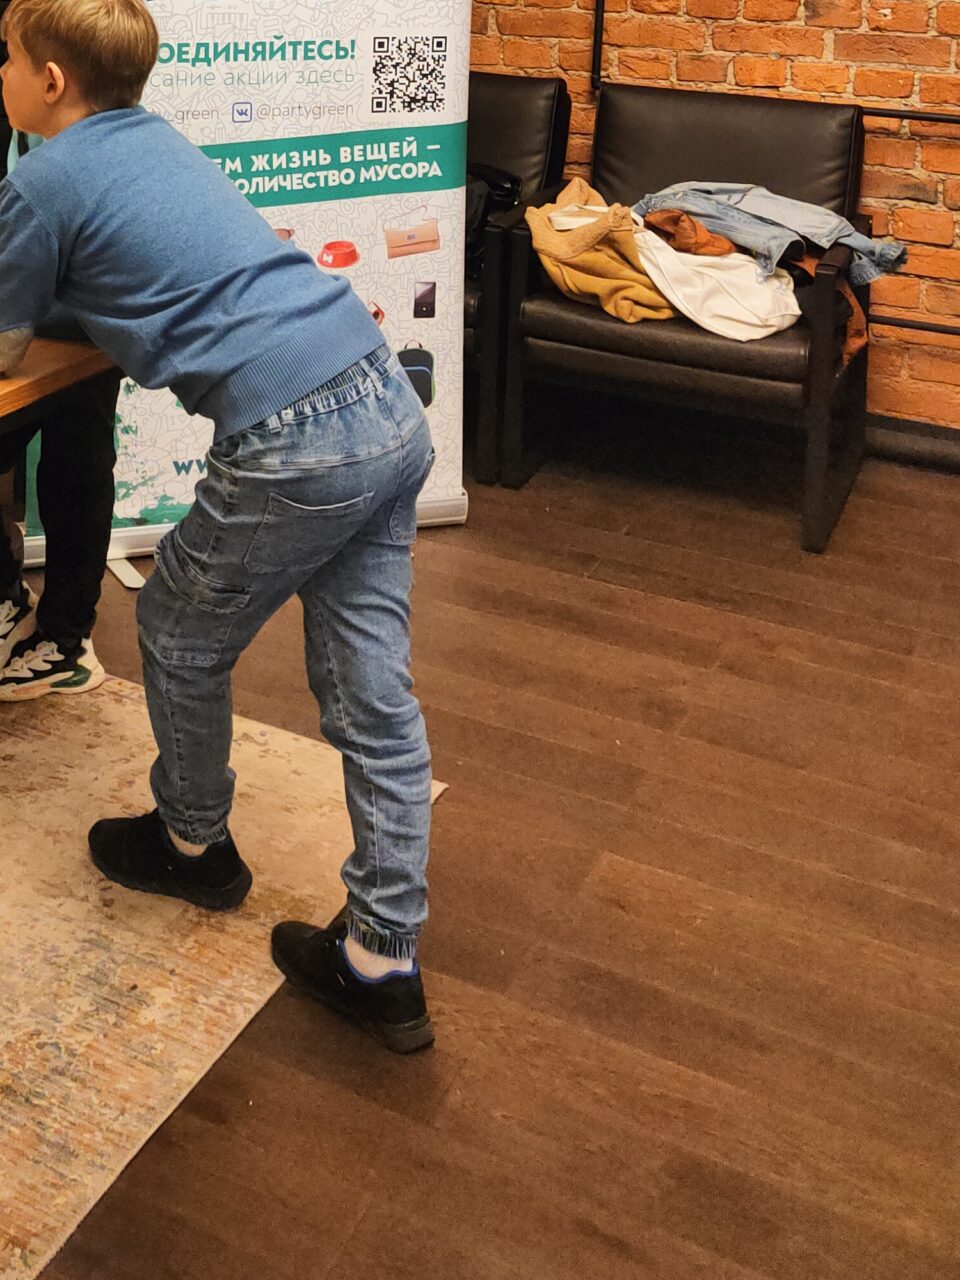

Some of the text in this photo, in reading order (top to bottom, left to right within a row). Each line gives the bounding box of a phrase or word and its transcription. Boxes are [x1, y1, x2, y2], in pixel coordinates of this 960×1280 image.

[156, 35, 356, 67] ОЕДИНЯЙТЕСЬ!
[149, 72, 216, 88] сание
[295, 69, 355, 86] здесь
[256, 103, 354, 120] @partygreen
[251, 148, 332, 172] ЖИЗНЬ
[339, 136, 417, 165] ВЕЩЕЙ
[230, 160, 442, 195] ОЛИЧЕСТВО МУСОРА
